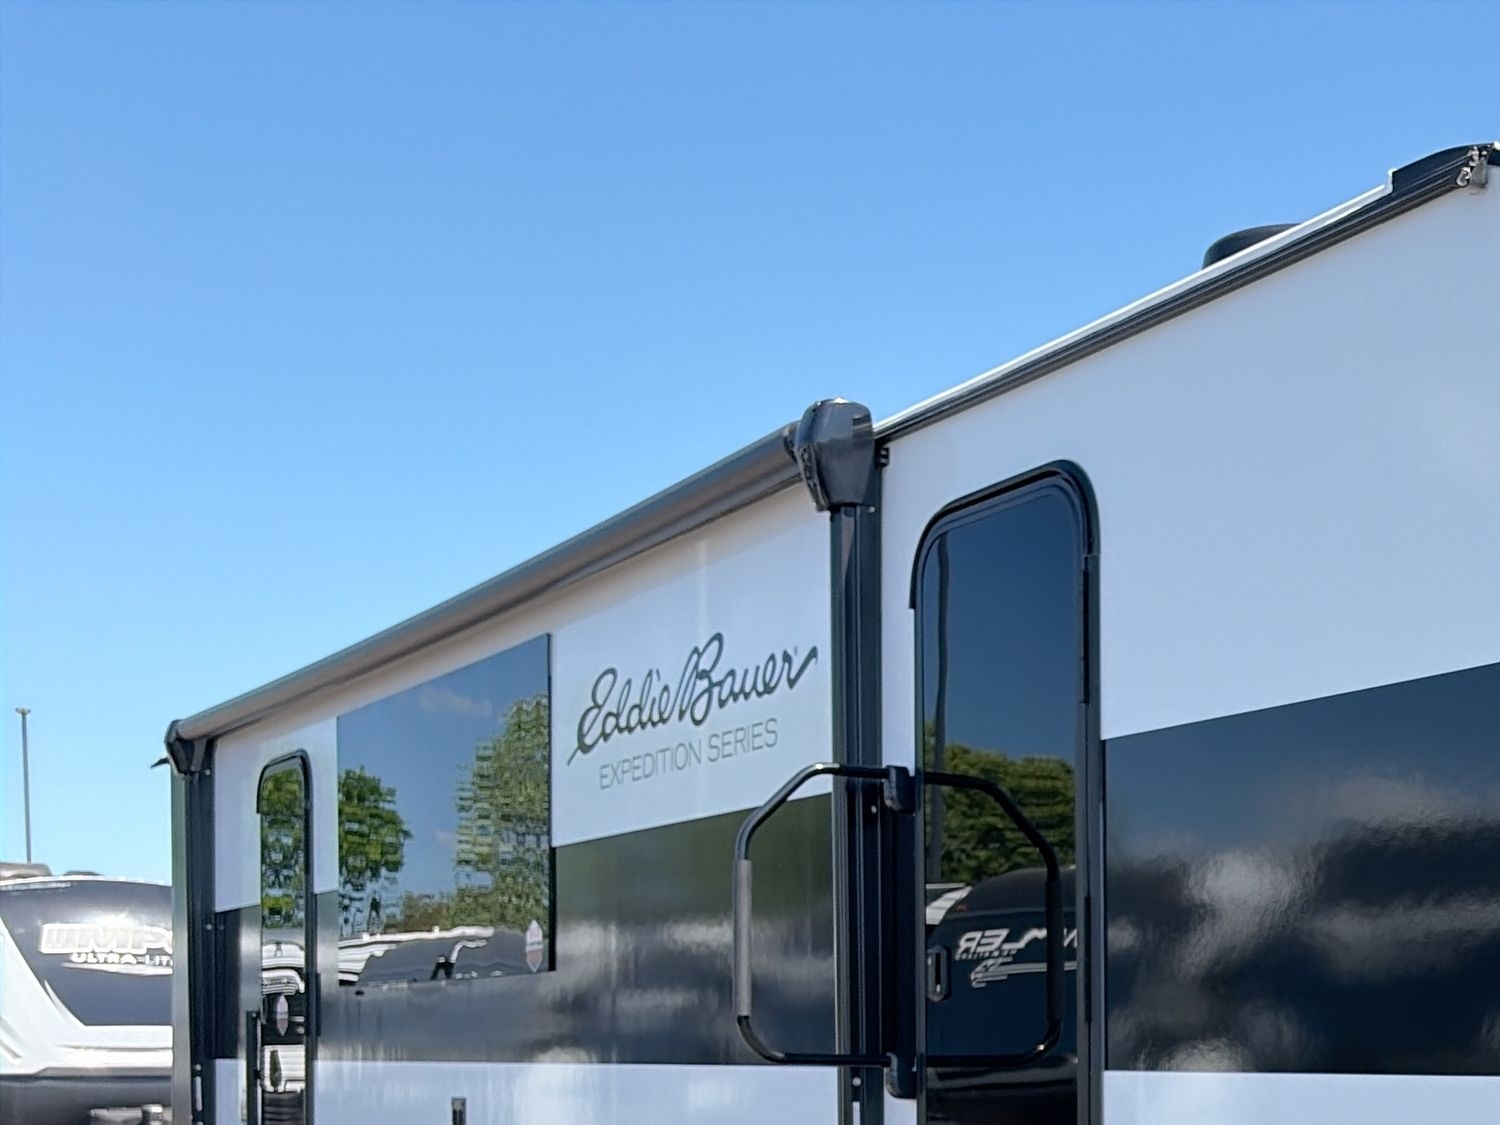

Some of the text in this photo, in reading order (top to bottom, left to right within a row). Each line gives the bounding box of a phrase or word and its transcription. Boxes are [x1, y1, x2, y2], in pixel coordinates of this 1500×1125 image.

[567, 632, 819, 767] Eddie Bauer
[600, 717, 779, 790] EXPEDITION SERIES
[70, 952, 173, 966] ULTRA-LIT
